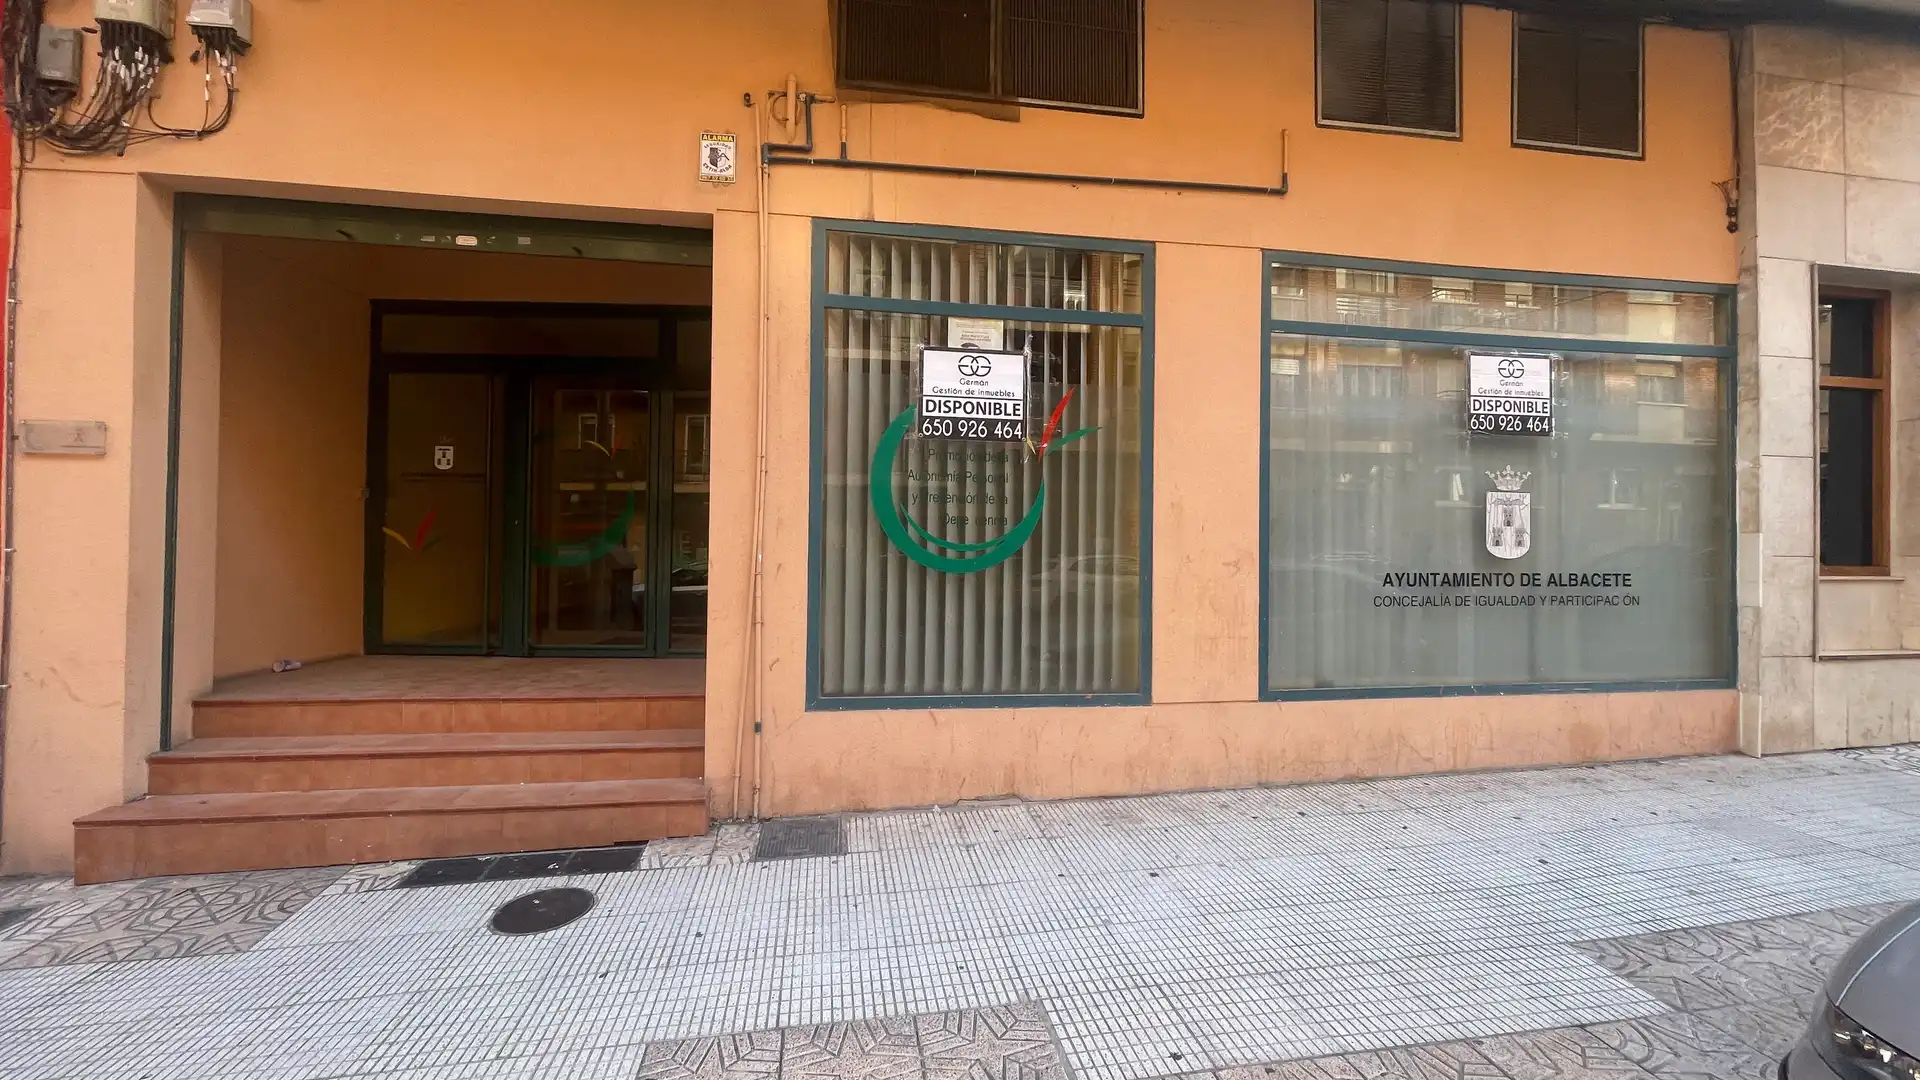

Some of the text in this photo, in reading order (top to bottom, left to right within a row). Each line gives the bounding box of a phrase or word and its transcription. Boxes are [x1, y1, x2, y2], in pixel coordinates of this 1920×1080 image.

[959, 378, 989, 387] Germán
[932, 386, 1015, 398] Gestión de inmuebles
[1478, 387, 1502, 395] Gestión
[1514, 389, 1544, 397] inmuebles
[926, 399, 1021, 417] DISPONIBLE
[1472, 399, 1548, 414] DISPONIBLE
[922, 418, 1022, 439] 650 926 464
[1470, 414, 1549, 432] 650 926 464
[912, 493, 918, 506] y
[1382, 572, 1632, 588] AYUNTAMIENTO DE ALBACETE
[1373, 593, 1452, 607] CONCEJALÍA
[1455, 596, 1470, 606] DE
[1475, 596, 1536, 607] IGUALDAD
[1540, 596, 1547, 606] Y
